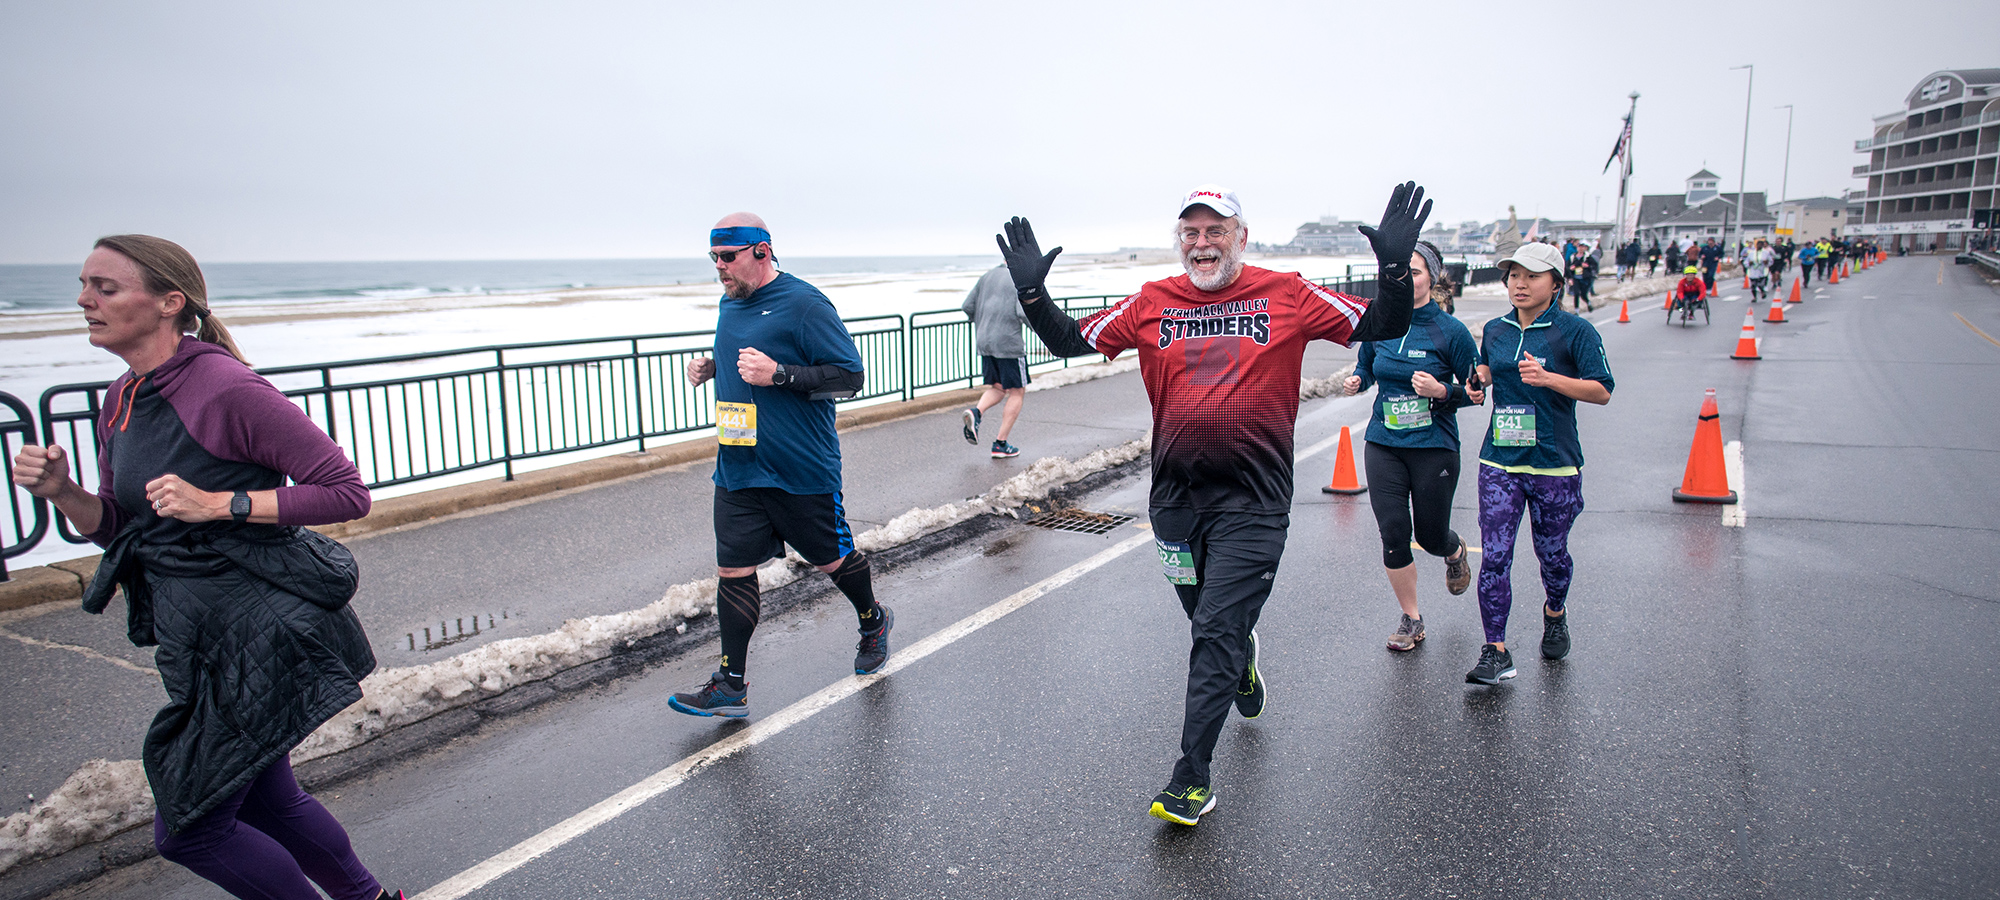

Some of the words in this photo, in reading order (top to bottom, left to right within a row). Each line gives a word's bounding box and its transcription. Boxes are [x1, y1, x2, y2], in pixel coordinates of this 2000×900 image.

[1161, 303, 1224, 318] MERRIMACK
[1227, 298, 1269, 314] VALLEY
[1158, 312, 1270, 350] STRIDERS
[1391, 400, 1419, 415] 642
[718, 412, 748, 428] 1441
[1496, 415, 1523, 429] 641
